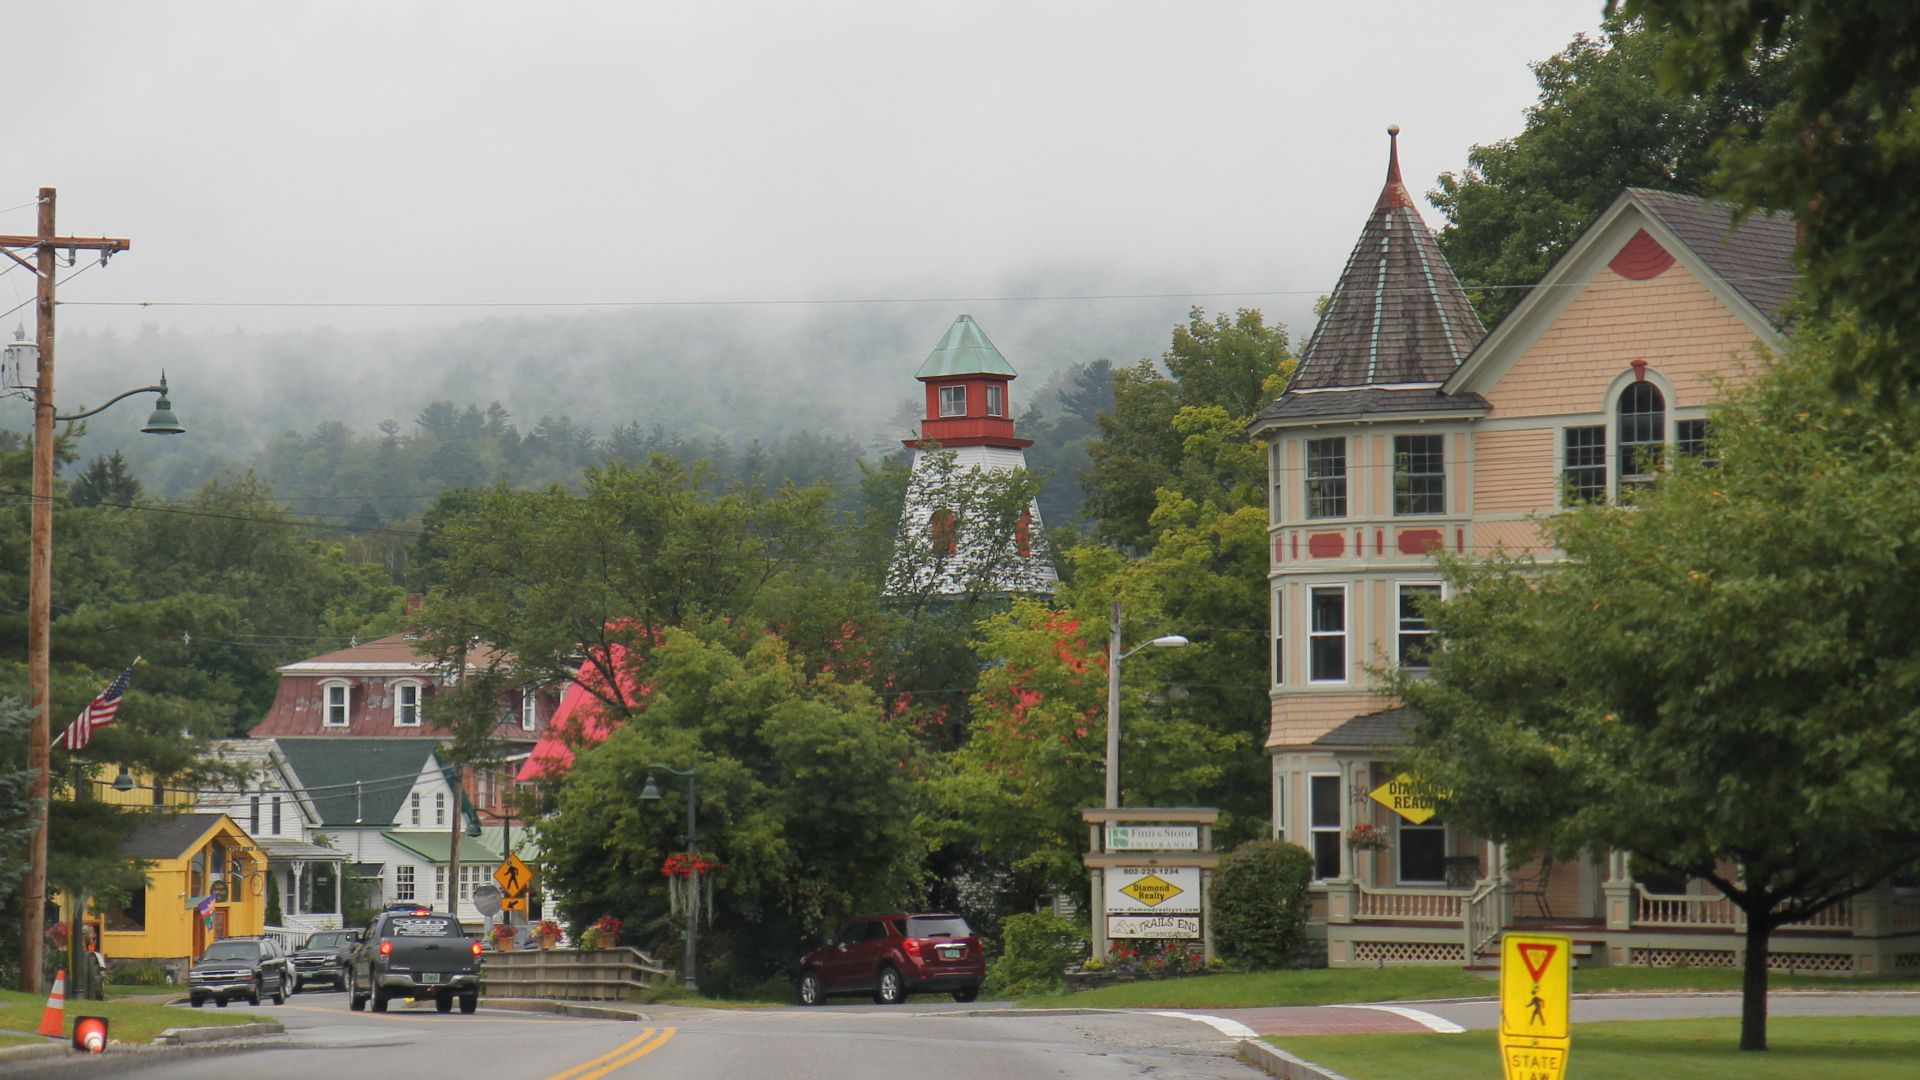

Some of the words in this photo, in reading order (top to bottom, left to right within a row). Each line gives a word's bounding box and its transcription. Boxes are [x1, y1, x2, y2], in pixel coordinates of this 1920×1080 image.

[1164, 829, 1194, 838] Stone
[1133, 884, 1170, 892] Diamond
[1138, 892, 1165, 901] Realty
[1140, 917, 1175, 932] TRAILS
[1177, 919, 1198, 933] END
[1512, 1054, 1558, 1070] STATE
